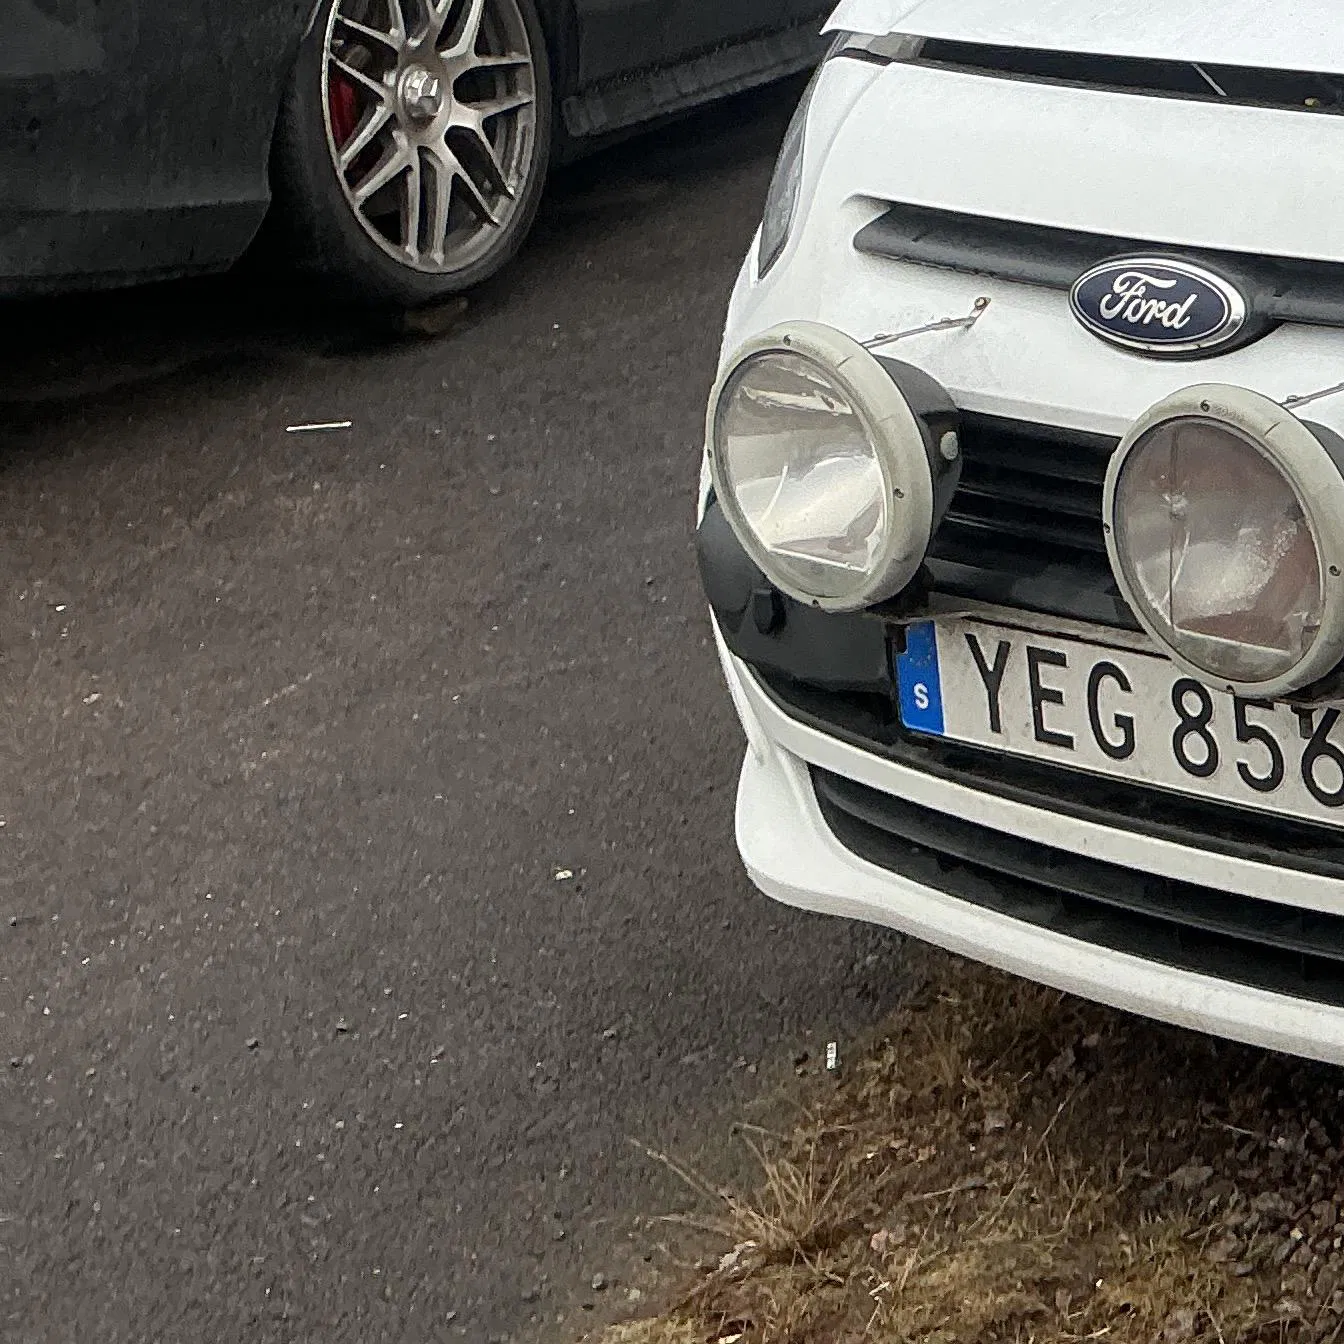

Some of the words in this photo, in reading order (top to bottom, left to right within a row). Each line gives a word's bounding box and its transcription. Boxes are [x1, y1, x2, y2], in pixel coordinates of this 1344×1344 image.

[1099, 271, 1197, 331] Ford
[914, 684, 930, 710] S
[965, 634, 1135, 760] YEG
